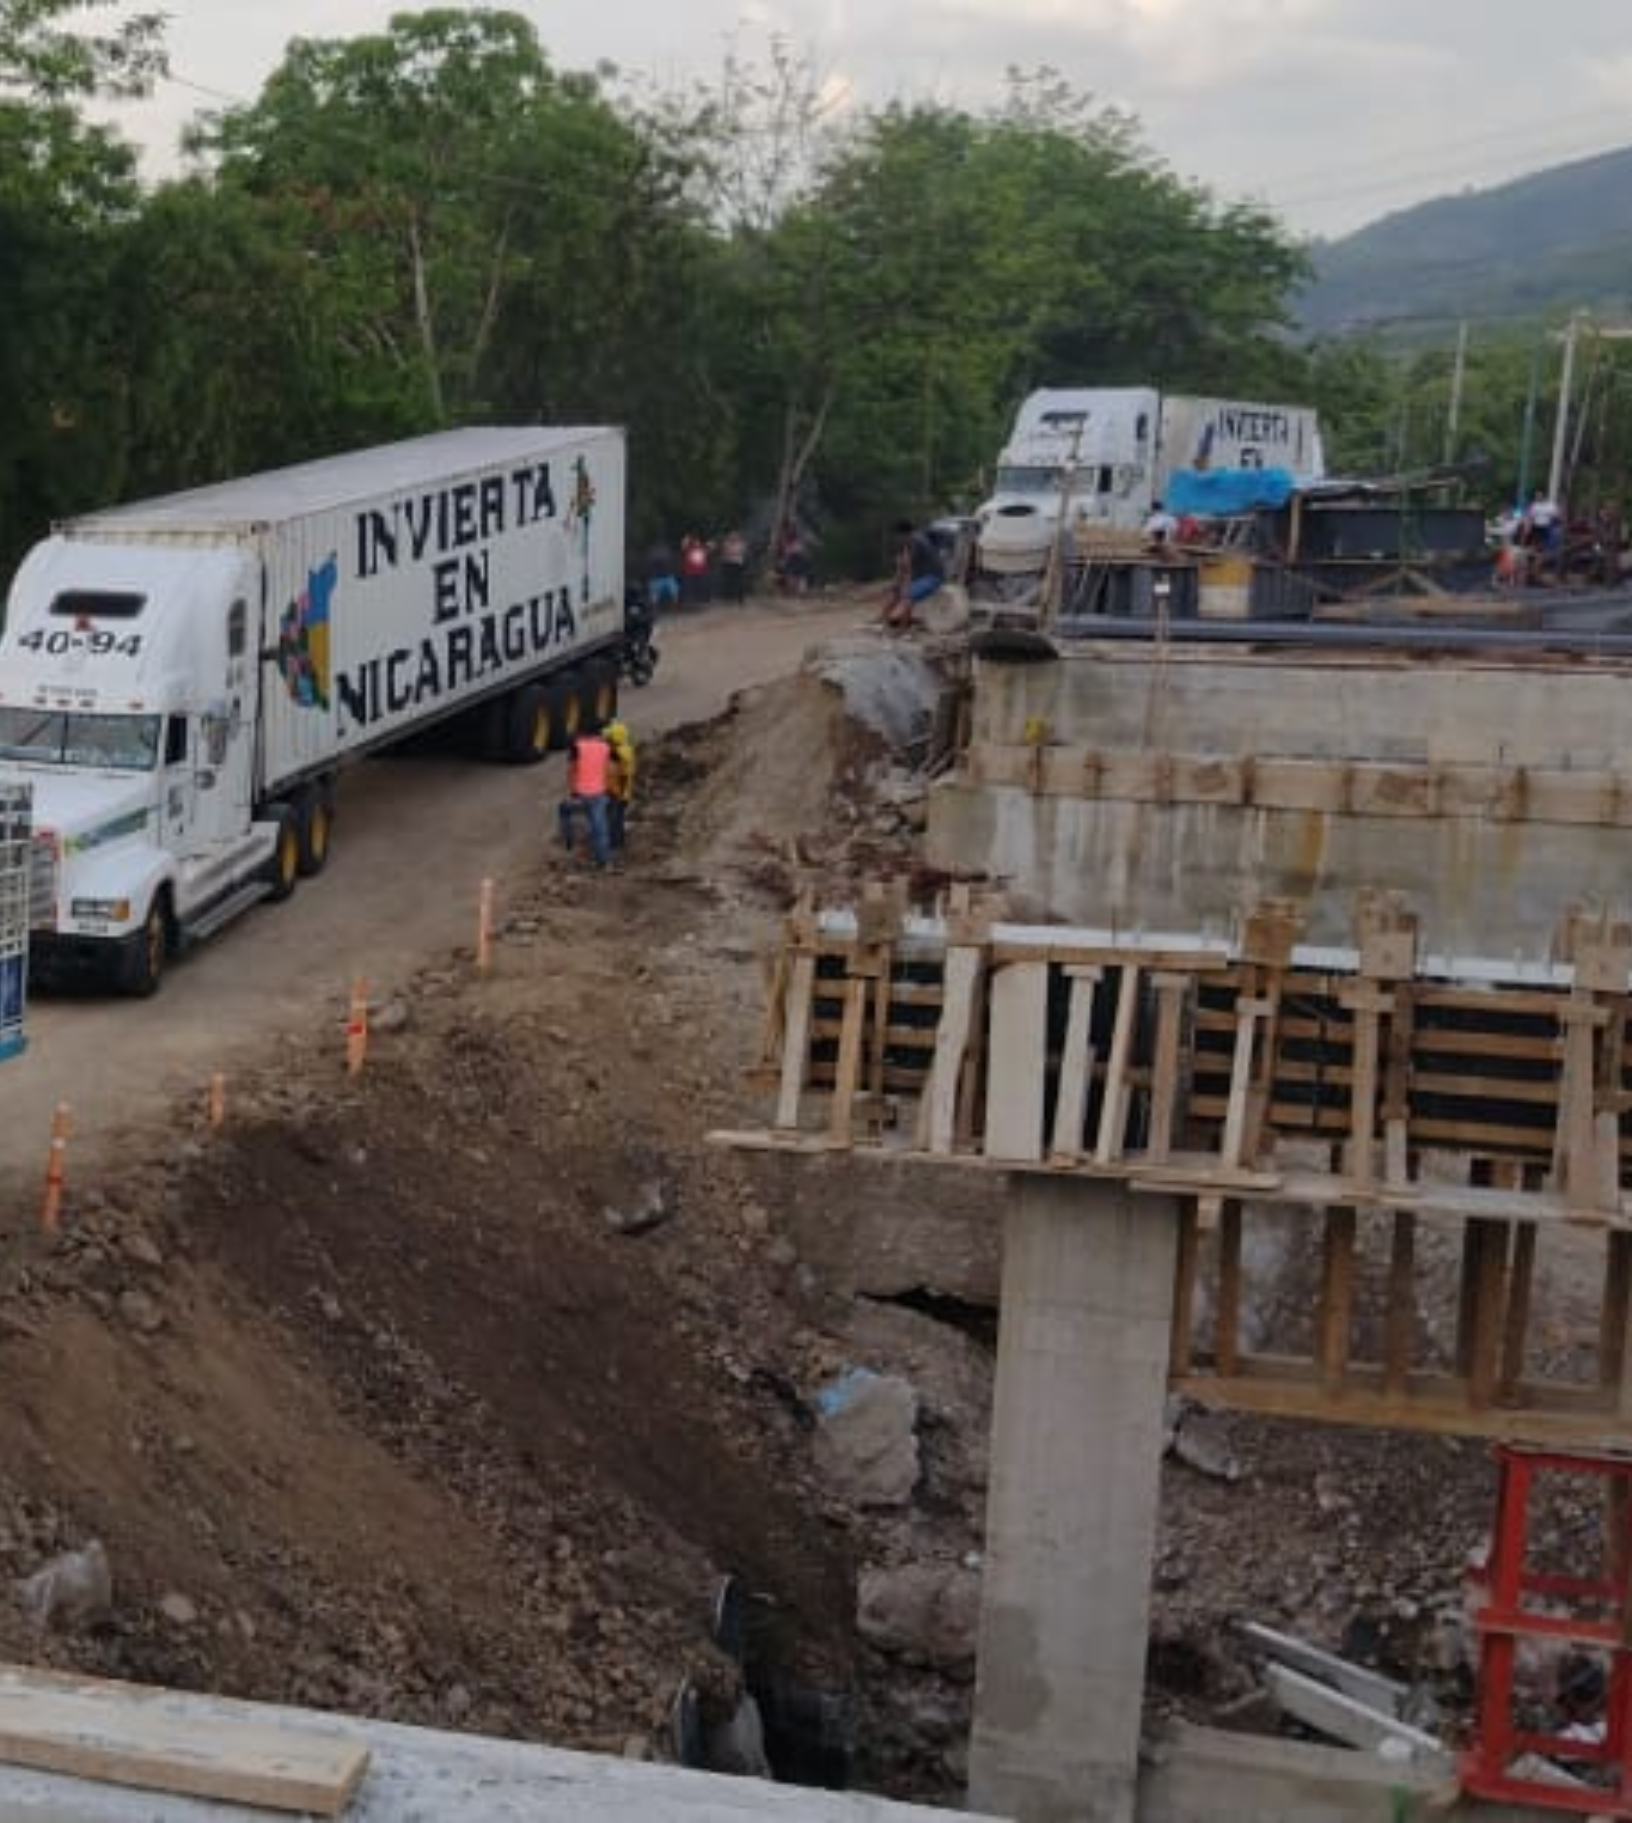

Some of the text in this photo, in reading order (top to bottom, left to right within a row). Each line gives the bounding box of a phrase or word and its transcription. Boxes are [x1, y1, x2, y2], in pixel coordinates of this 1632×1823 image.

[355, 461, 556, 578] INVIERTA
[432, 548, 490, 624] EN
[19, 630, 144, 657] 40-94
[335, 586, 576, 738] NICARAGUA
